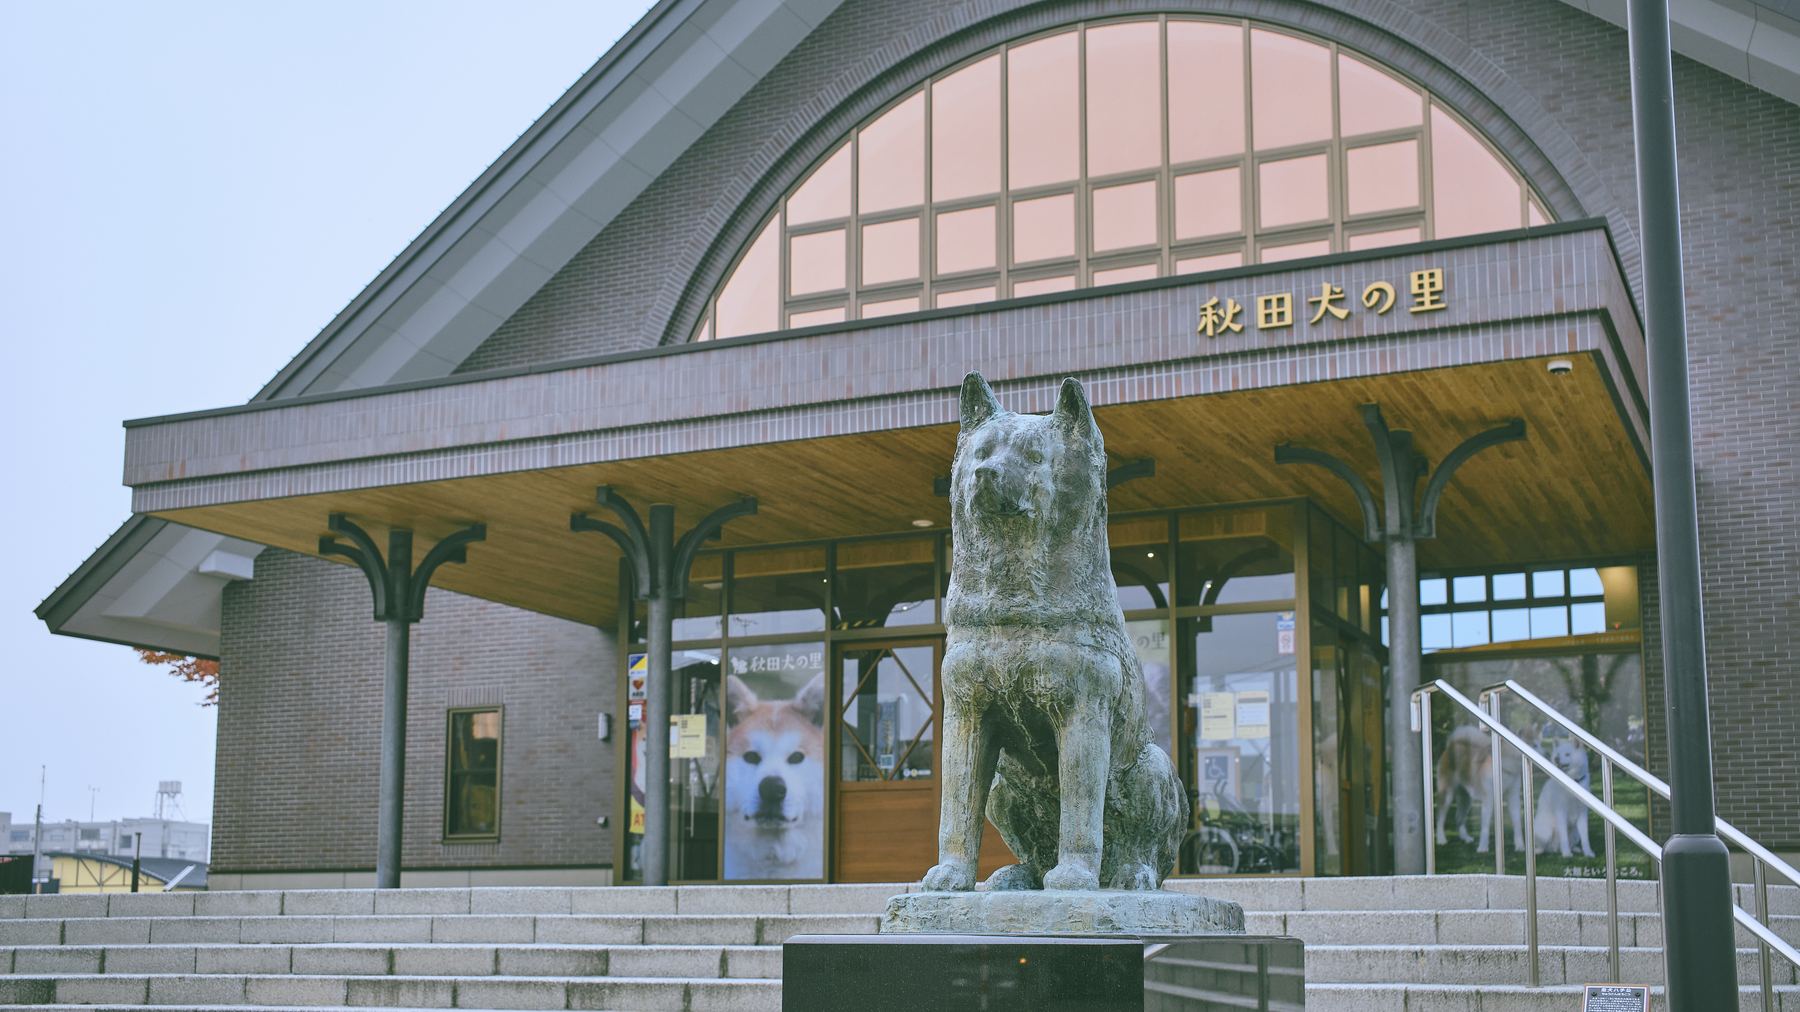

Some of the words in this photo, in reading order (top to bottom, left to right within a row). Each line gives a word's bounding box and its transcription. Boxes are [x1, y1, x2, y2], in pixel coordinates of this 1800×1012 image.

[1197, 267, 1448, 337] 秋田犬の里
[750, 652, 822, 673] 秋田犬の里
